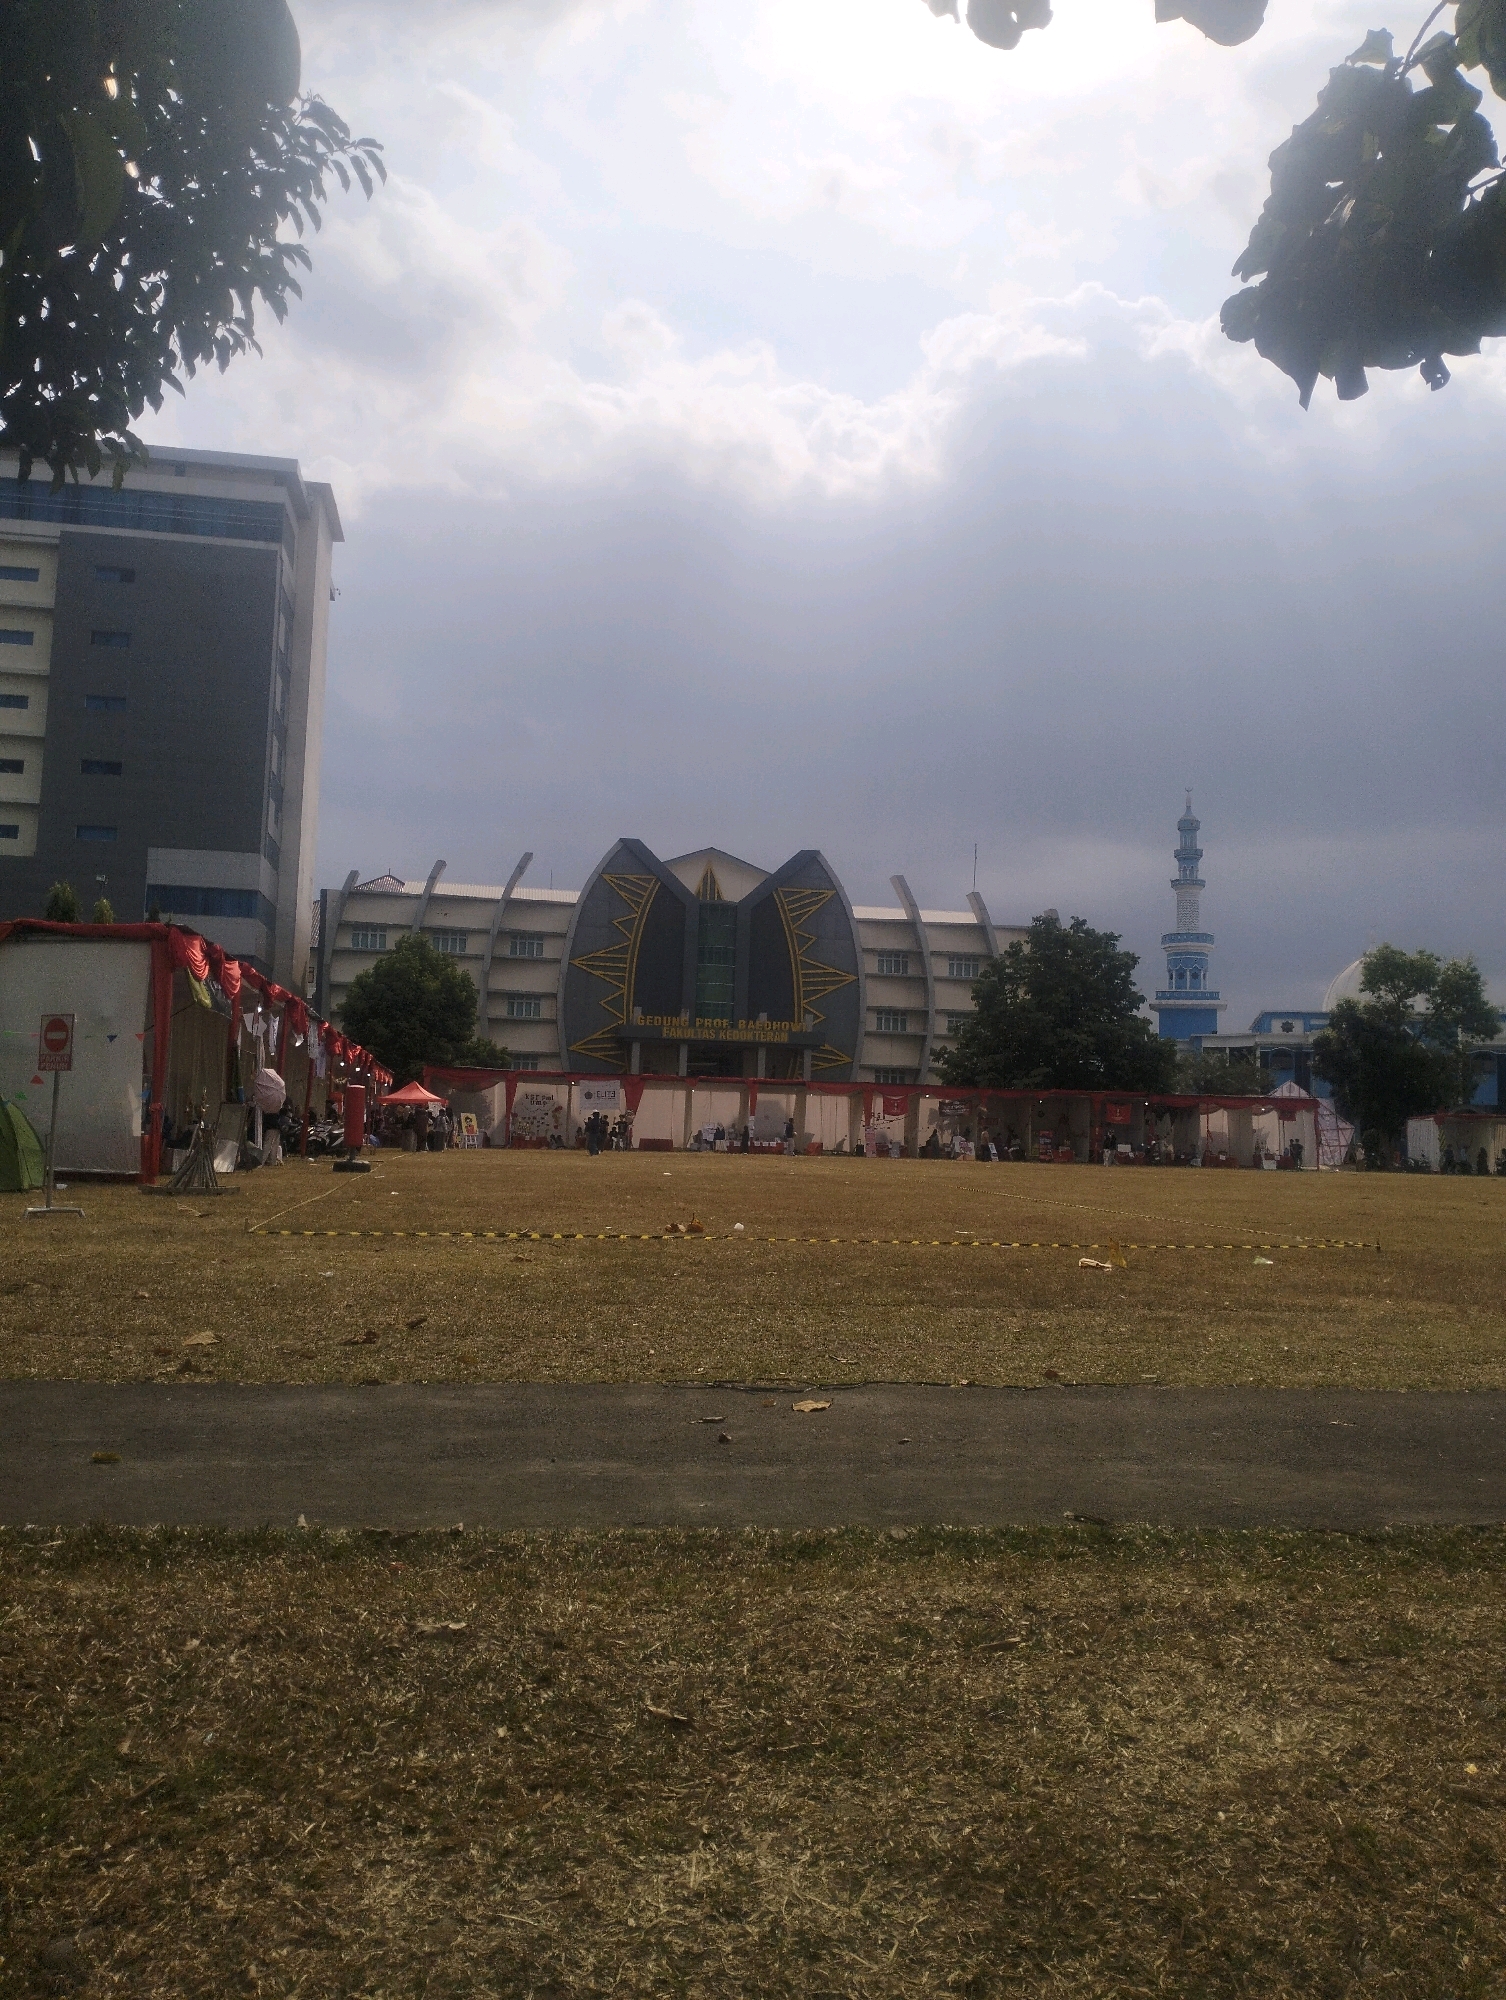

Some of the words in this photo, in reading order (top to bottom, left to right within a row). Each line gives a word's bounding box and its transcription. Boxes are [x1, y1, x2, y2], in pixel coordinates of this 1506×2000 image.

[637, 1015, 689, 1027] GEDUNG
[662, 1027, 716, 1039] FAKULTAS
[719, 1029, 789, 1043] KEDOKTERAN
